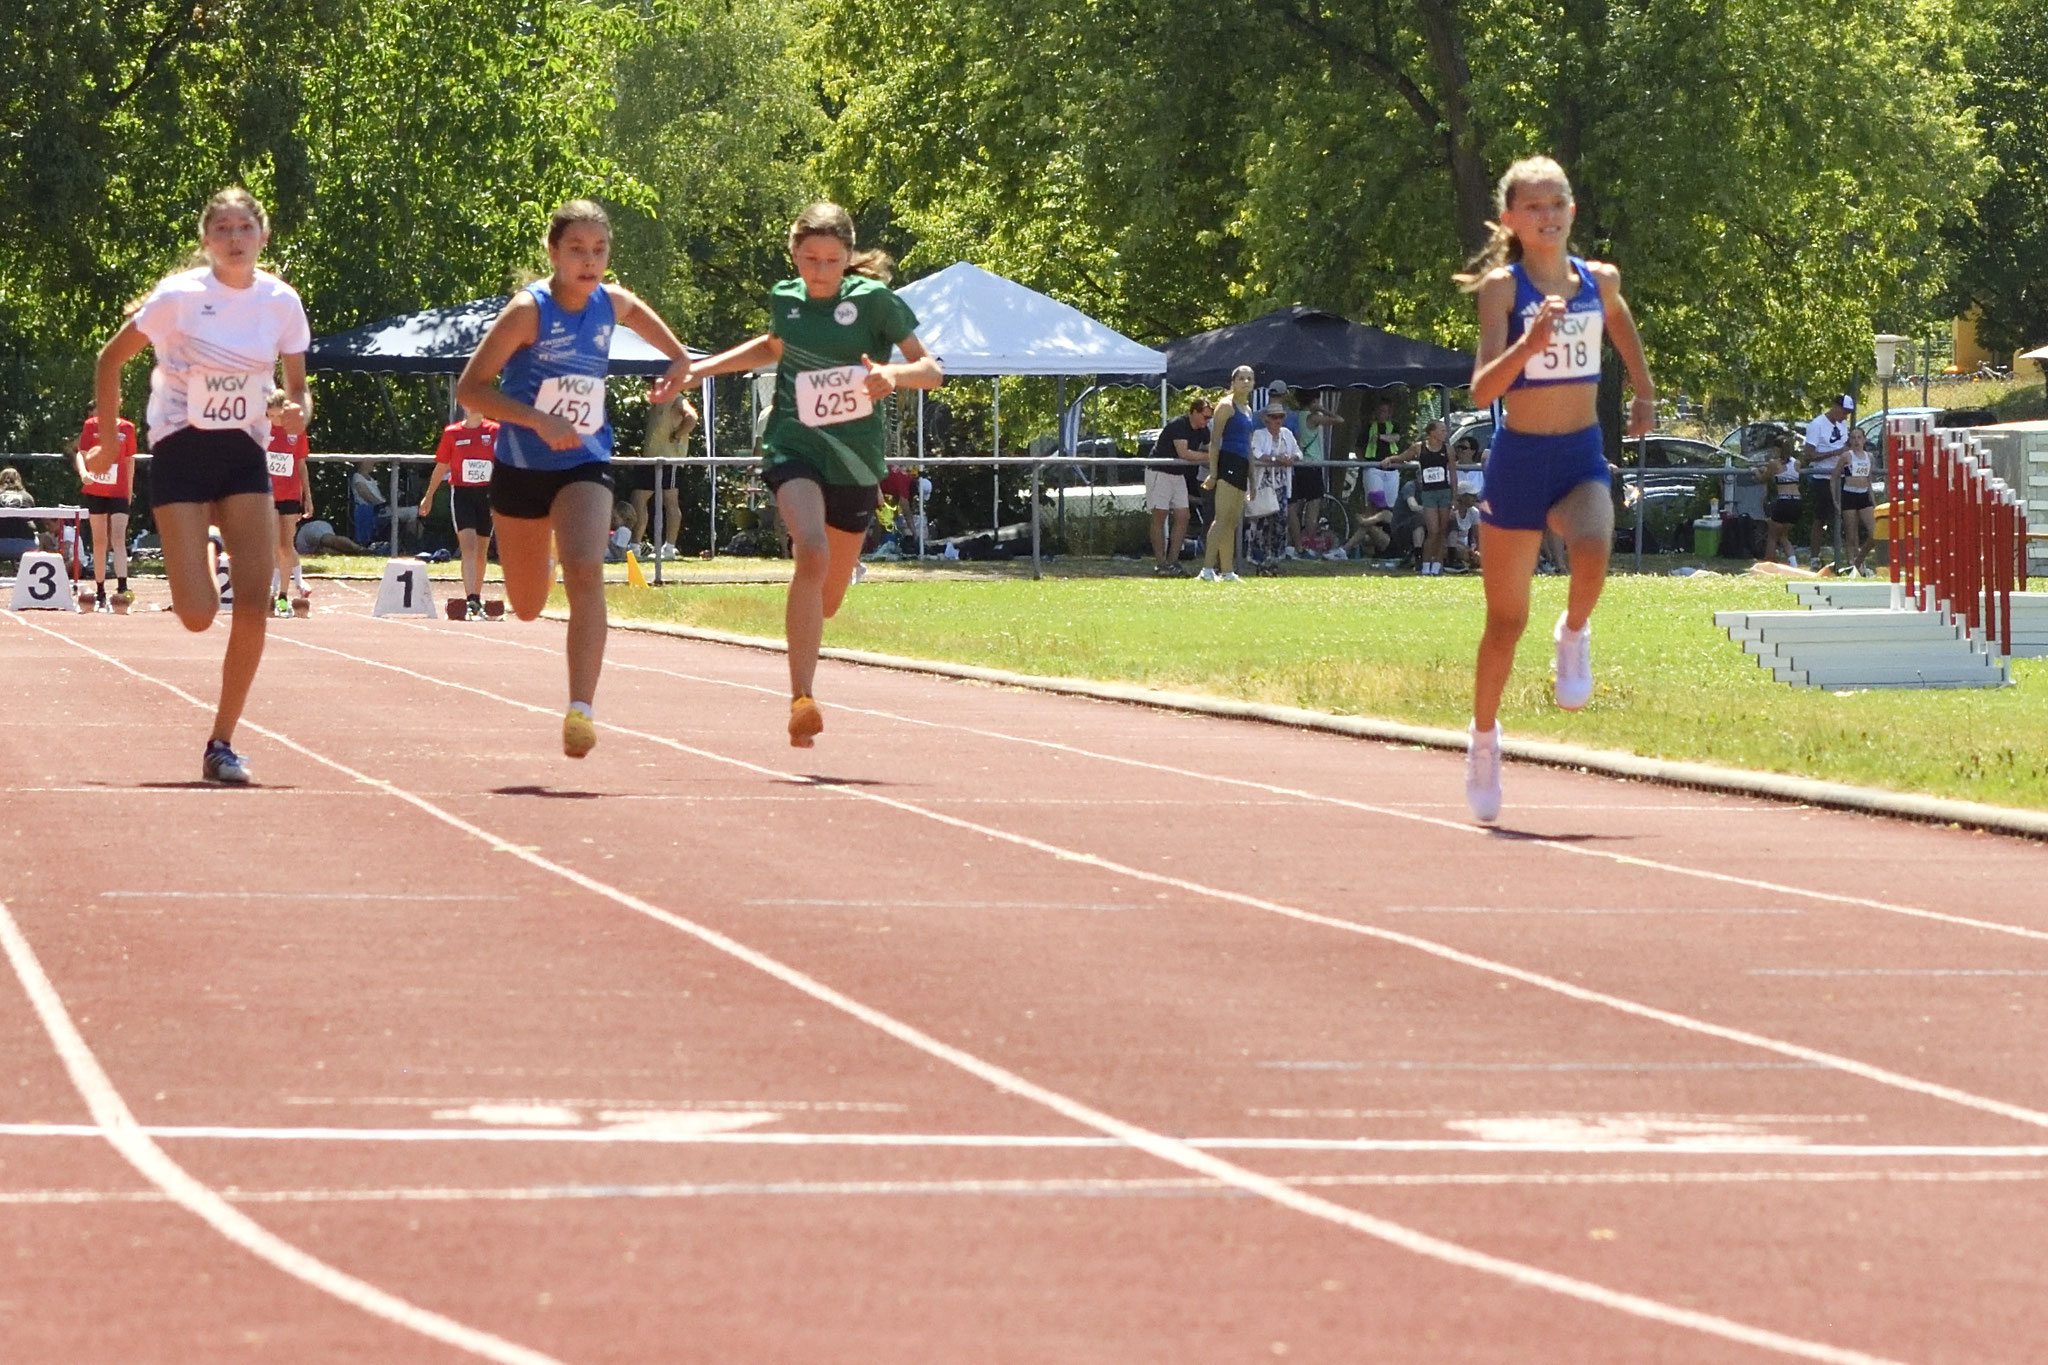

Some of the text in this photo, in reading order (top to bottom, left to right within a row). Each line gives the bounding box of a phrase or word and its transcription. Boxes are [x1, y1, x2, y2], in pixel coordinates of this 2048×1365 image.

[1543, 341, 1588, 370] 518
[205, 374, 249, 392] WGV
[812, 368, 853, 390] WGV
[203, 396, 247, 422] 460
[549, 398, 592, 427] 452
[814, 390, 857, 418] 625
[269, 461, 287, 473] 626
[468, 461, 488, 469] WGV
[468, 470, 486, 481] 556
[28, 561, 57, 601] 3
[396, 570, 413, 608] 1
